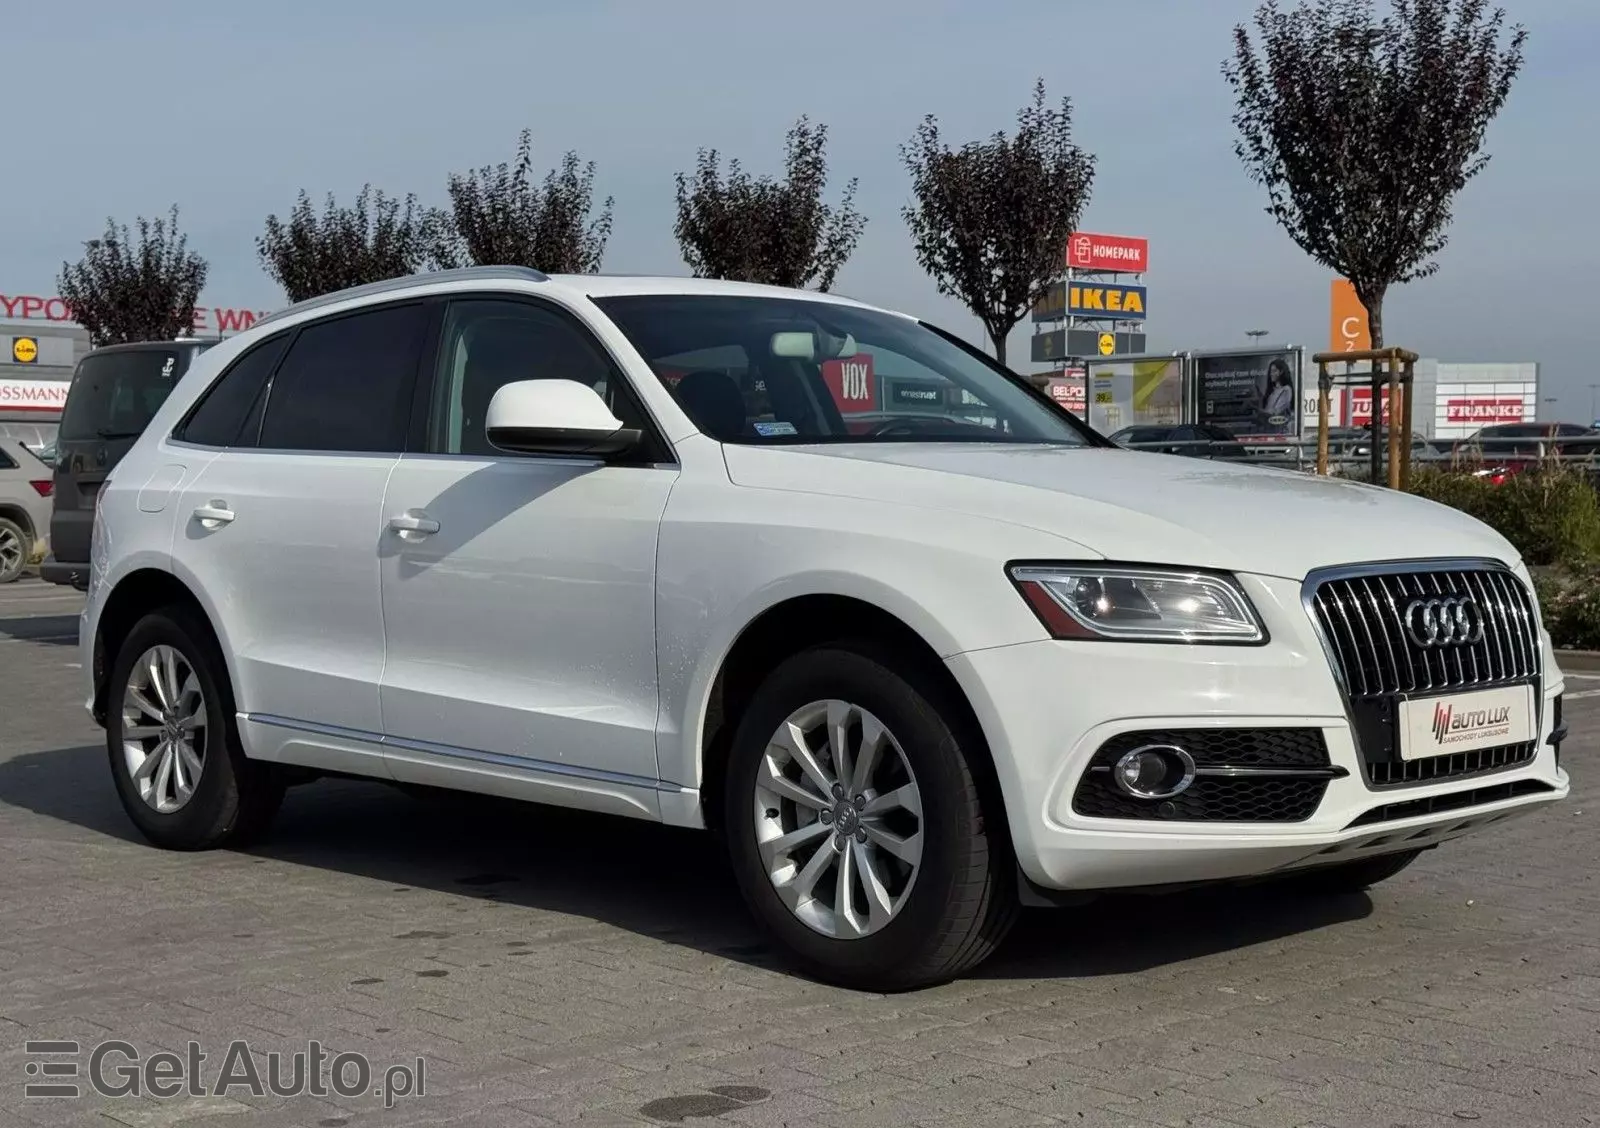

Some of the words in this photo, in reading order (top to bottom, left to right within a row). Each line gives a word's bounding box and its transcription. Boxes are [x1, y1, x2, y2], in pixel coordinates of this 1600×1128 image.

[1092, 244, 1141, 261] HOMEPARK
[1070, 287, 1144, 313] IKEA
[1341, 316, 1360, 339] C
[841, 362, 869, 401] VOX
[0, 385, 68, 401] SSMANN
[1448, 404, 1524, 418] FRANKE
[1487, 705, 1511, 725] LUX
[1443, 732, 1477, 744] SAMOCHODY
